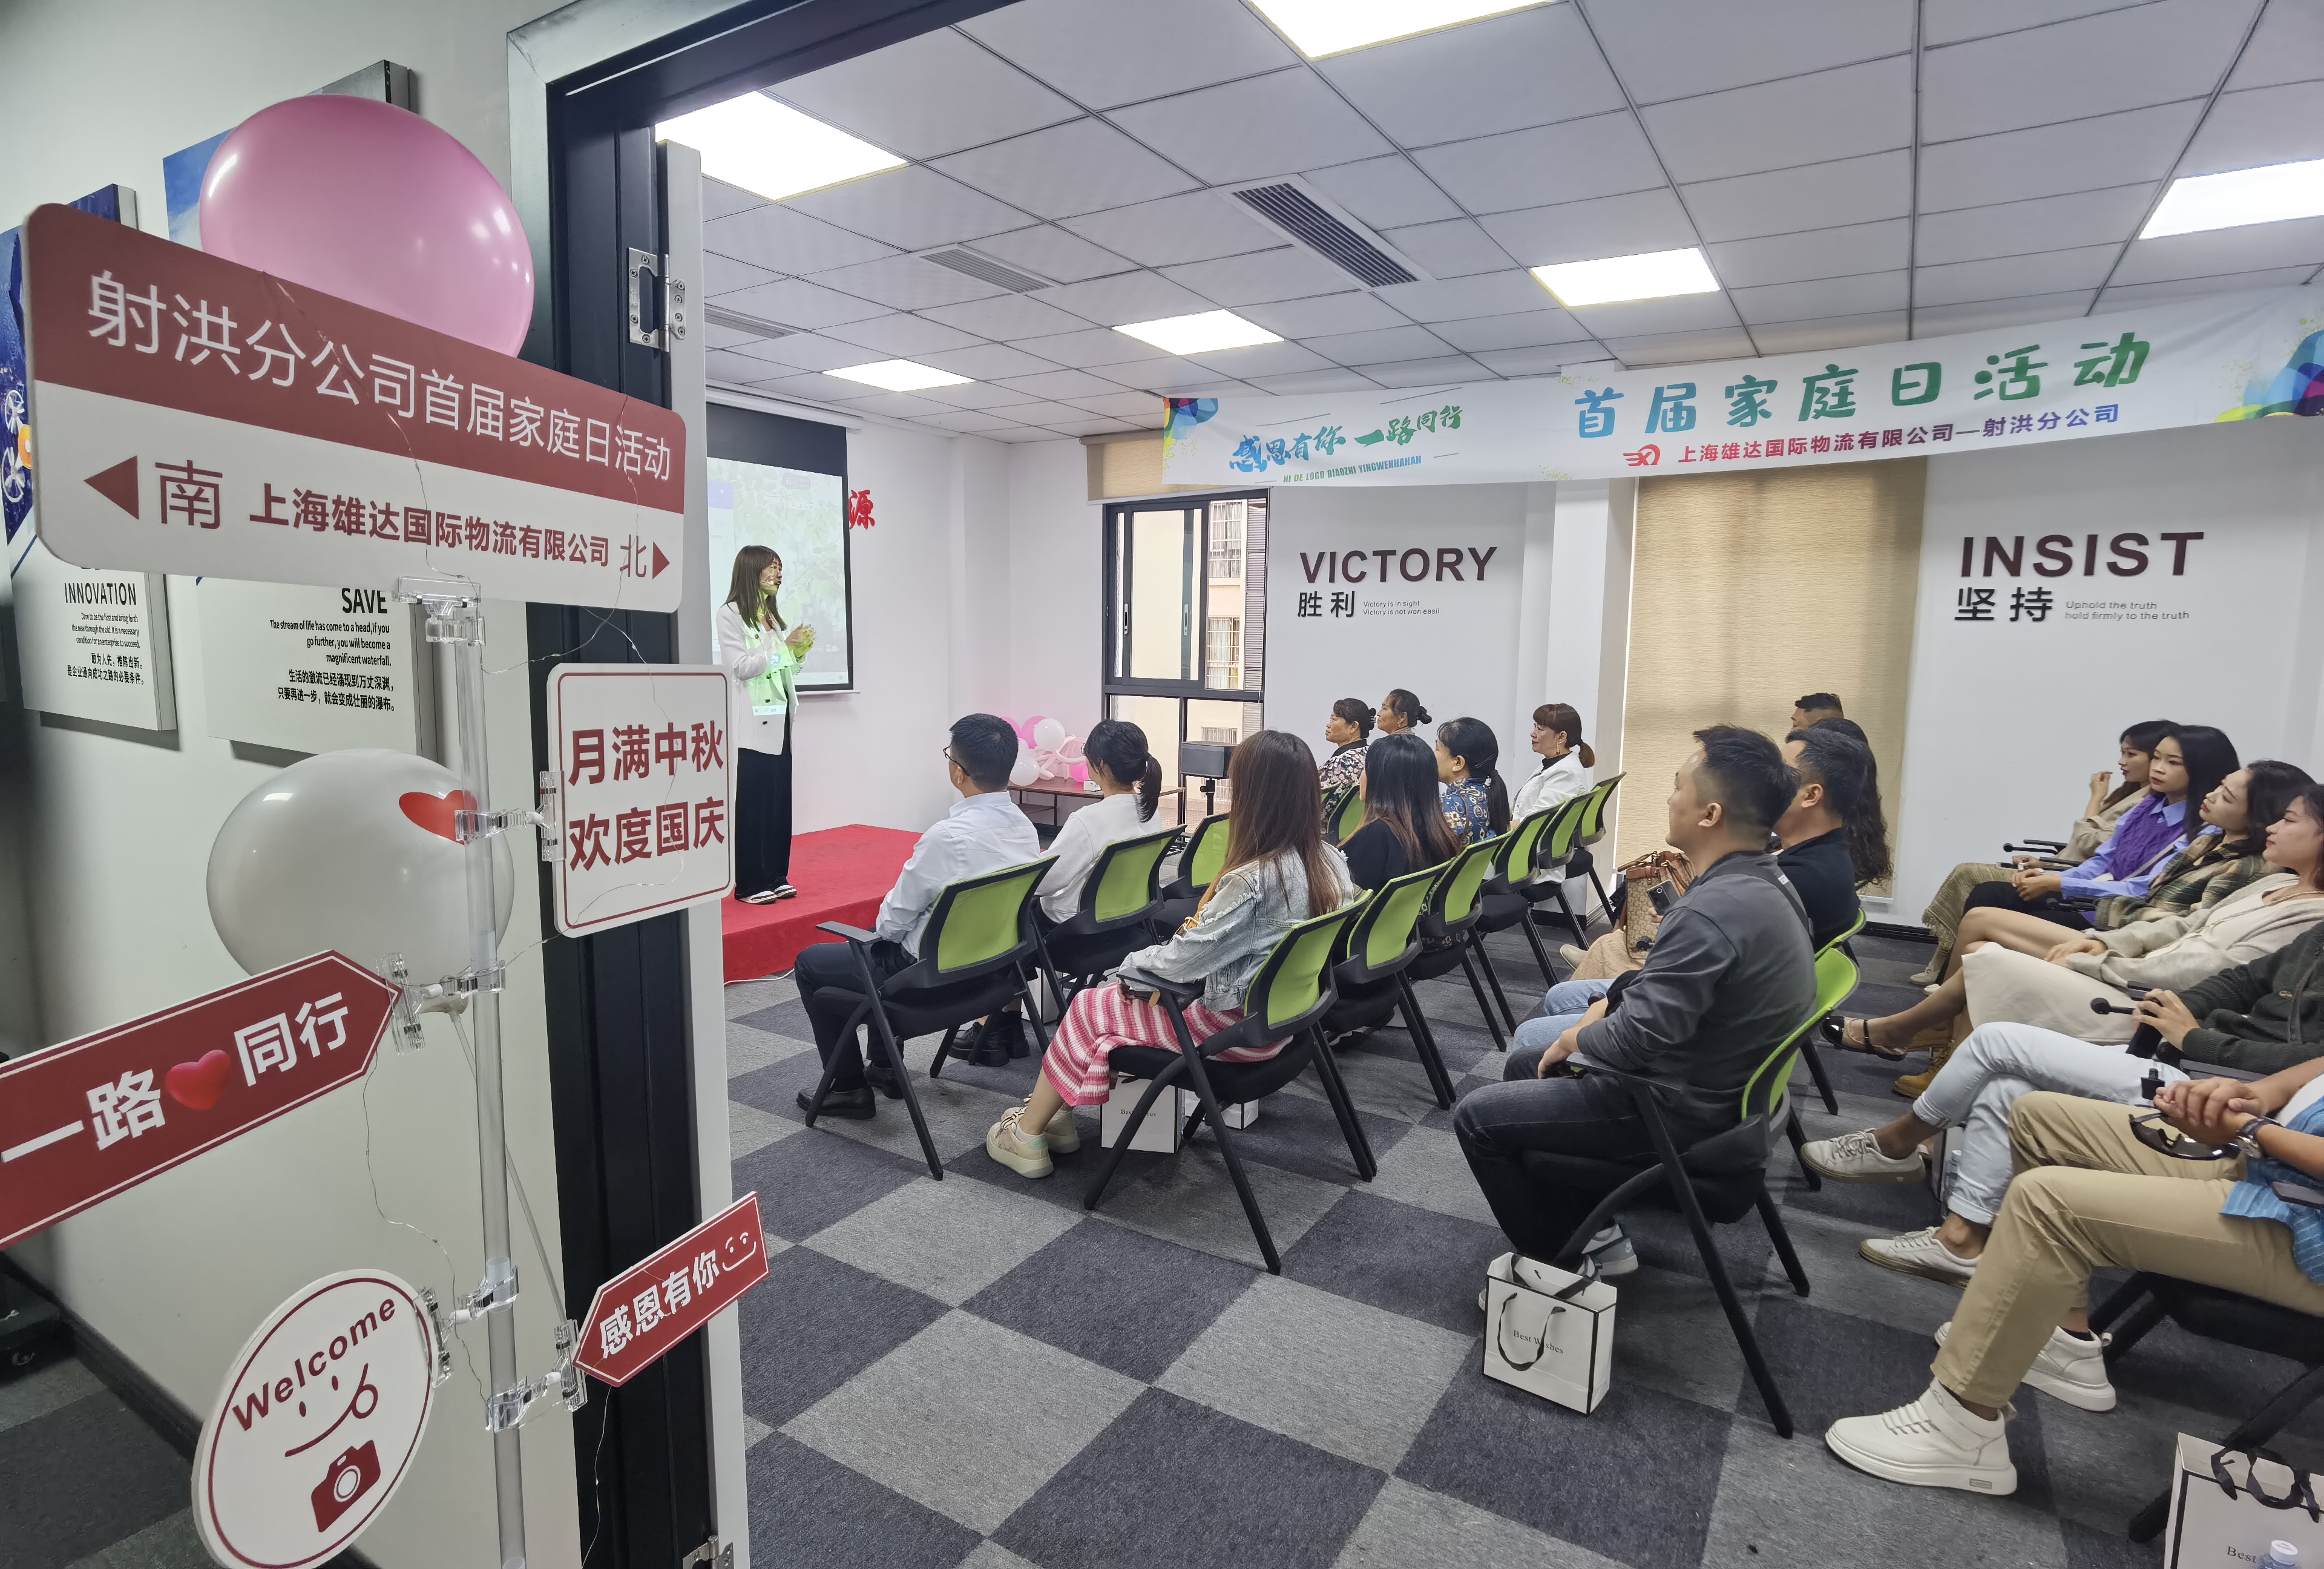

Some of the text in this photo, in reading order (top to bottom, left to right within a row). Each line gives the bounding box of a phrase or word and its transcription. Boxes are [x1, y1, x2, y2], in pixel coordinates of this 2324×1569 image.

[88, 270, 670, 481] 射洪分公司首届家庭日活动
[1575, 332, 2150, 438] 首届家庭日活动
[1229, 405, 1463, 473] 感恩有你 一路同行
[1294, 473, 1303, 482] DE
[1306, 470, 1325, 481] LOGO
[1327, 466, 1357, 478] BIAOZHI
[155, 459, 646, 577] 南 上海雄达国际物流有限公司 北
[1299, 547, 1498, 584] VICTORY
[1961, 531, 2204, 577] INSIST
[64, 582, 137, 605] INNOVATION
[341, 588, 388, 614] SAVE
[1297, 590, 1355, 618] 胜利
[1954, 587, 2053, 622] 坚持
[2066, 600, 2106, 610] Uphold
[269, 619, 280, 630] The
[280, 620, 299, 630] stream
[299, 620, 305, 631] of
[305, 620, 315, 631] life
[315, 620, 326, 631] has
[326, 623, 343, 632] come
[343, 622, 350, 632] to
[377, 625, 390, 636] you
[2092, 612, 2124, 621] firmly
[2140, 611, 2159, 620] the
[2162, 611, 2190, 619] truth
[121, 629, 139, 637] necessary
[307, 636, 391, 650] go further, you will become a
[326, 653, 392, 666] magnificent waterfall.
[277, 686, 395, 712] 只要再进一步，就会变成壮丽的瀑布。
[568, 720, 724, 786] 月满中秋
[569, 796, 725, 872] 欢度国庆
[1, 992, 349, 1162] 一路 同行
[600, 1249, 720, 1359] 感恩有你
[1513, 1329, 1564, 1354] Best Wshes
[232, 1298, 396, 1432] Welcome
[2227, 1545, 2257, 1564] Best
